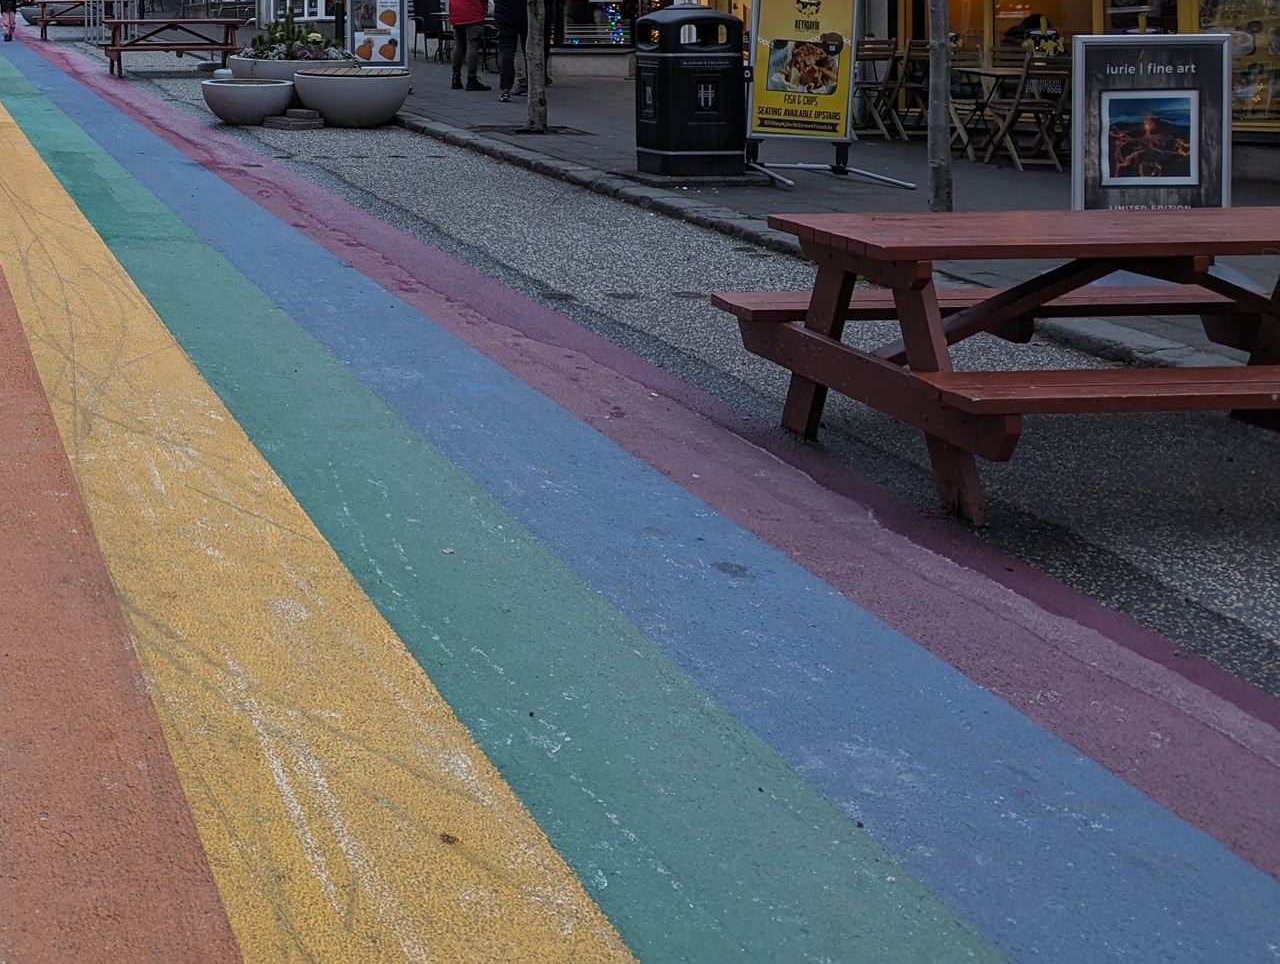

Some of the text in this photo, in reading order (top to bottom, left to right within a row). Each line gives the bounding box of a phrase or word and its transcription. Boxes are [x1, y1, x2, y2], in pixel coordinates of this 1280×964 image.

[1106, 63, 1197, 75] iurie fine art
[784, 94, 797, 104] FISH
[802, 95, 818, 106] CHIPS
[757, 106, 841, 121] SEATING AVAILABLE UPSTAIRS
